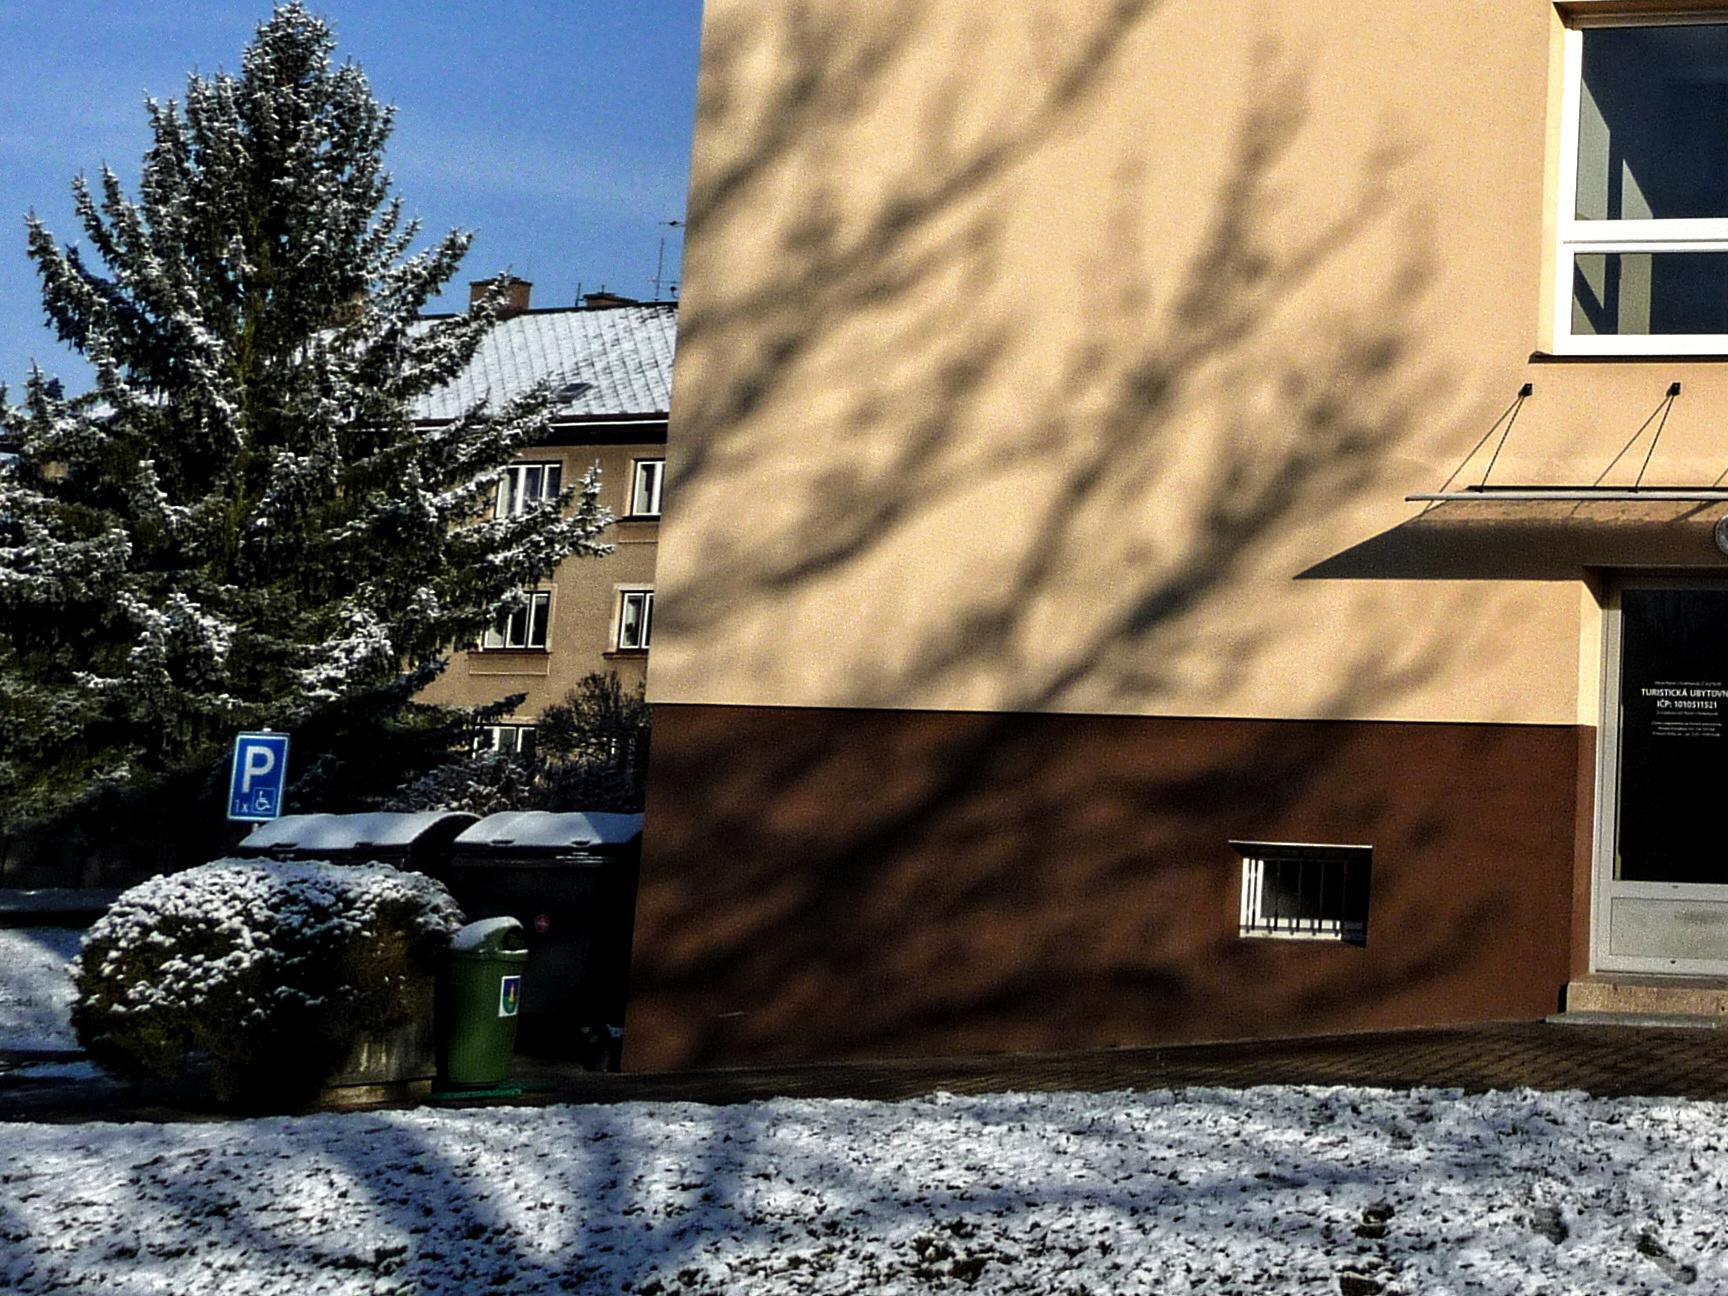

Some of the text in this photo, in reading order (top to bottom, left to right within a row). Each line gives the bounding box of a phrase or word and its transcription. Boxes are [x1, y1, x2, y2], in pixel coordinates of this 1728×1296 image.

[1641, 688, 1688, 697] TURISTICKÁ
[241, 745, 276, 794] P
[233, 799, 249, 814] 1x
